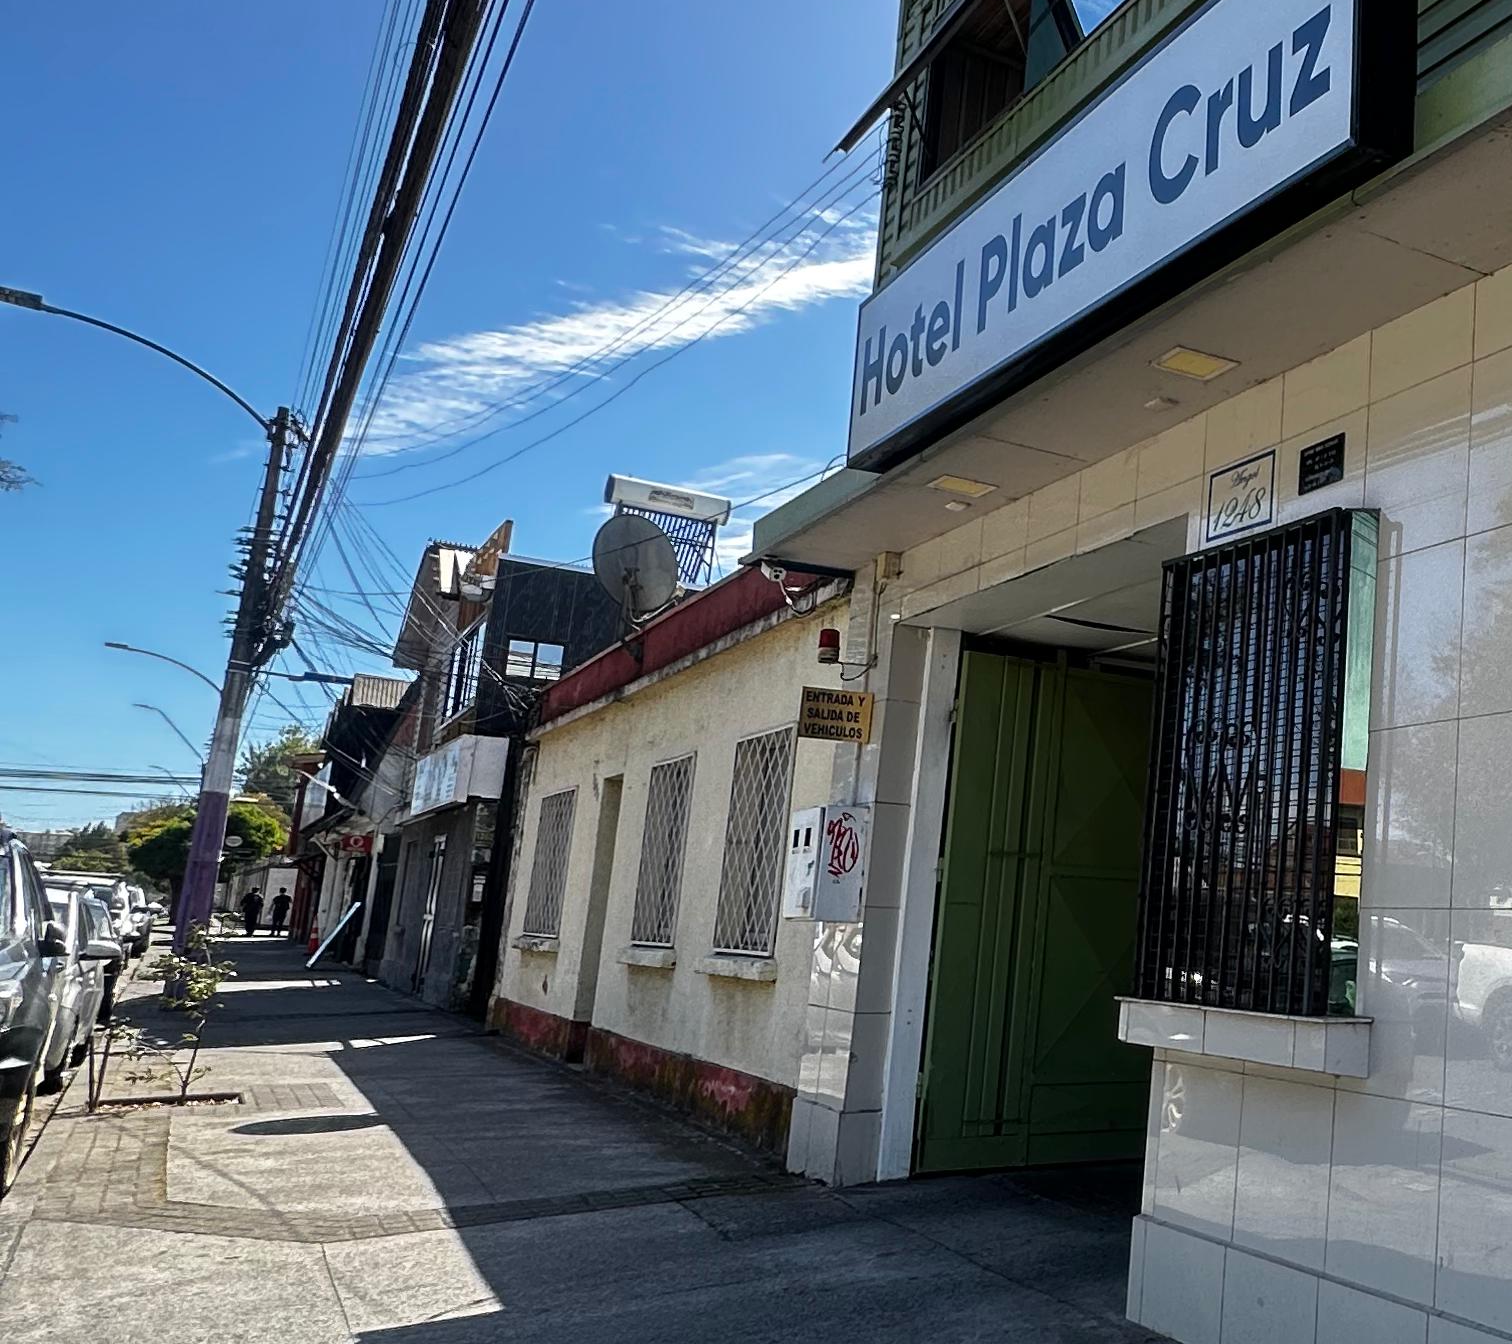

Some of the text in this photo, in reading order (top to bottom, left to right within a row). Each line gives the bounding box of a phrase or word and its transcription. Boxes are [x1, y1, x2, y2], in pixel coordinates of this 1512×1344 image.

[859, 3, 1332, 417] Hotel Plaza Cruz
[1213, 486, 1267, 532] 1248
[805, 690, 867, 707] ENTRADA Y
[806, 707, 861, 724] SALIDA DE
[803, 722, 863, 739] VEHICULOS
